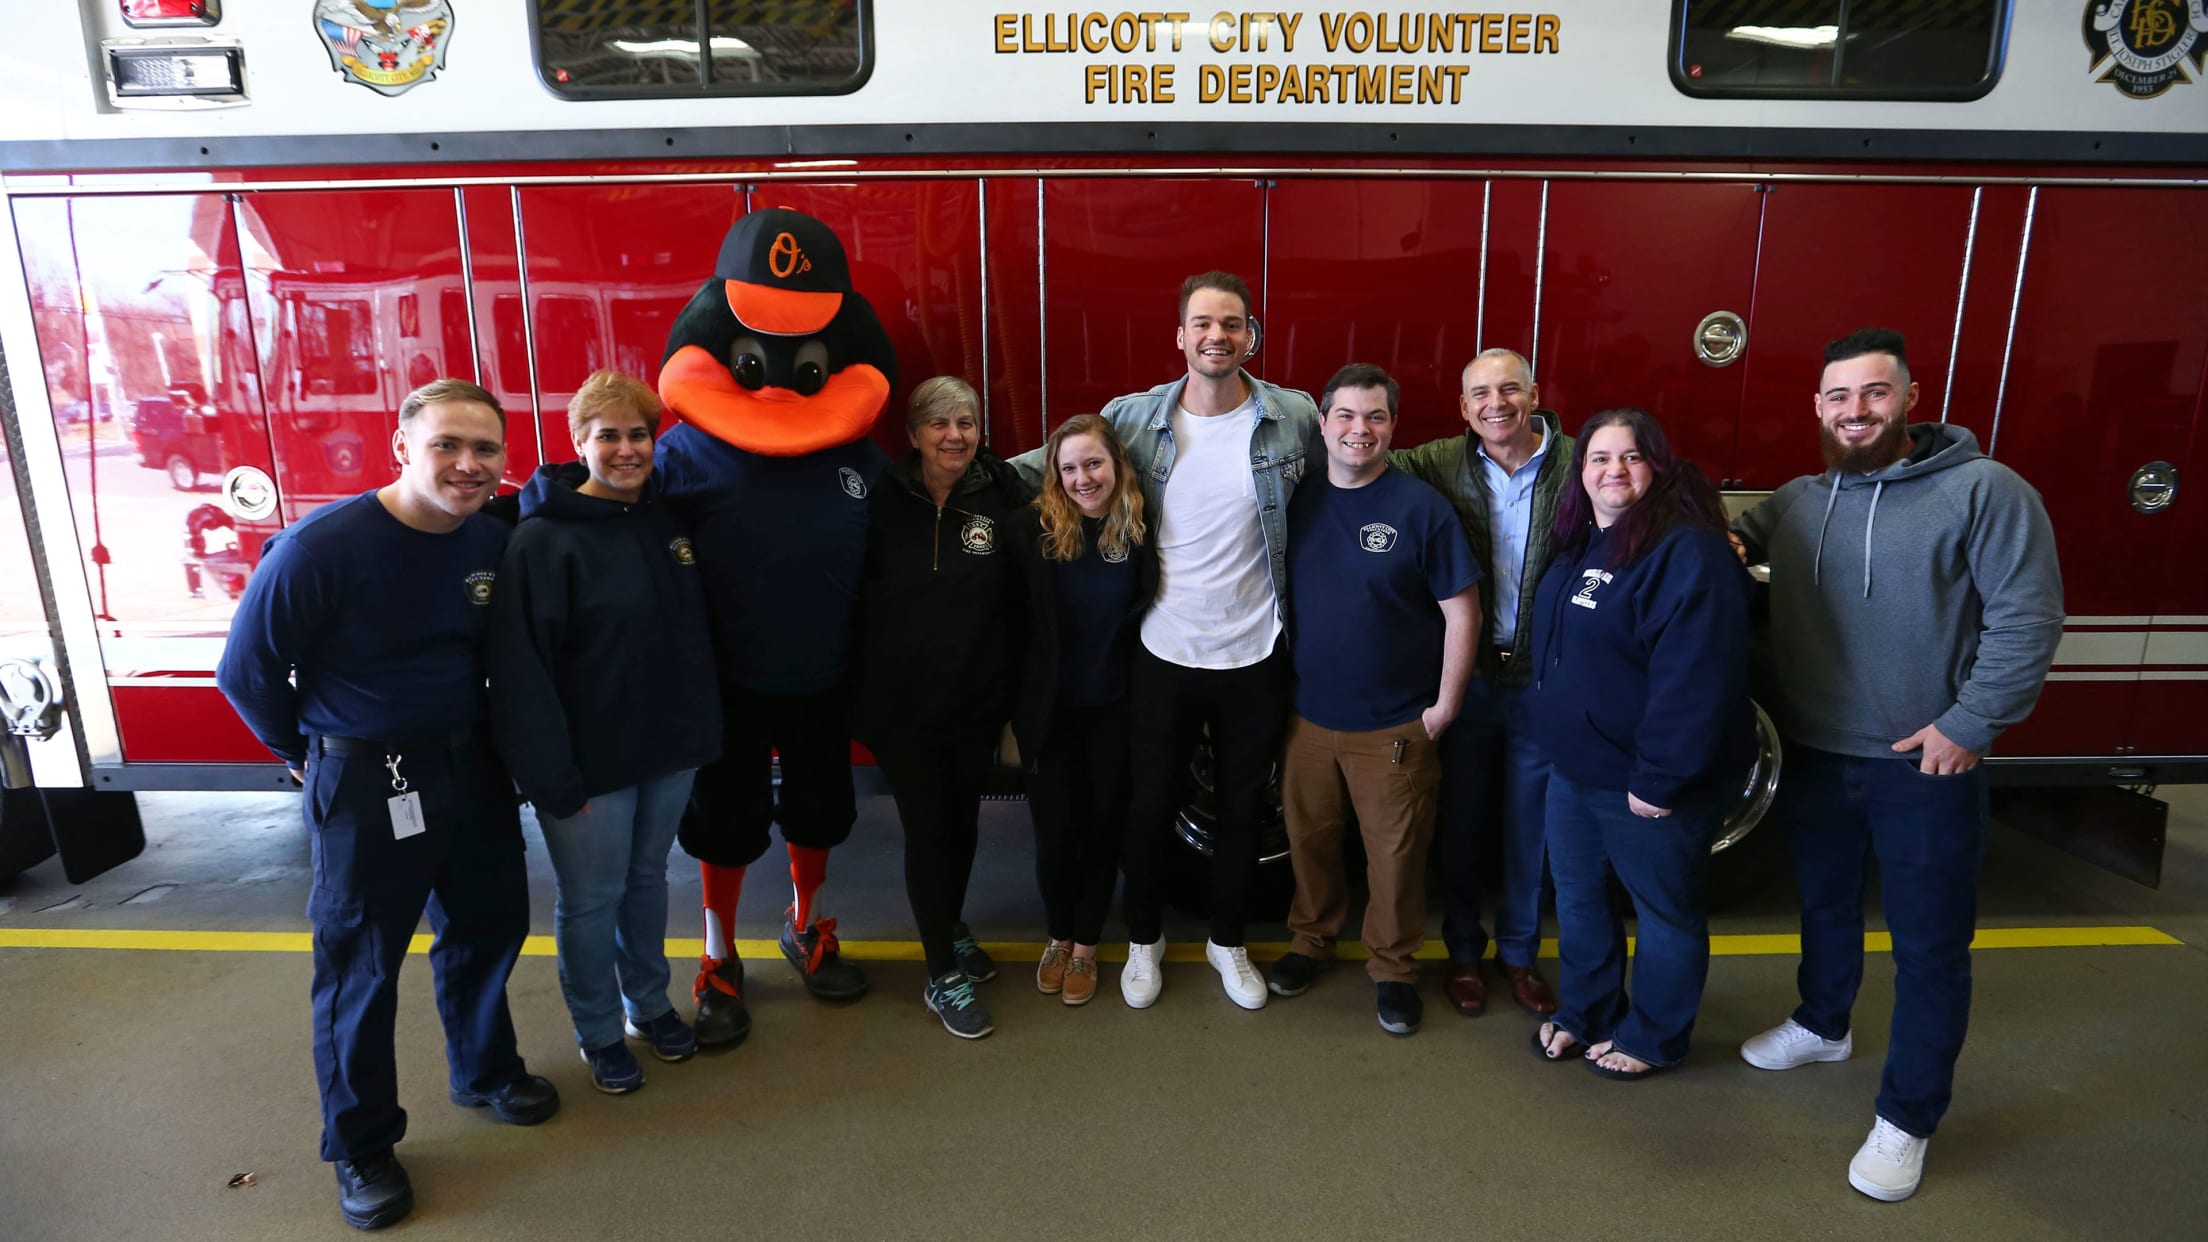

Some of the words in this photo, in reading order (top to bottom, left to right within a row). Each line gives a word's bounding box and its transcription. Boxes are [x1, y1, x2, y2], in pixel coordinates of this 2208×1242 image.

[994, 11, 1189, 53] ELLICOTT
[1208, 11, 1303, 53] CITY
[1319, 11, 1561, 54] VOLUNTEER
[2113, 47, 2153, 70] JOSEPH
[2155, 32, 2194, 70] STIGLER
[1085, 64, 1175, 104] FIRE
[1199, 64, 1470, 104] DEPARTMENT
[2113, 67, 2167, 84] DECEMBER
[1578, 577, 1601, 600] 2
